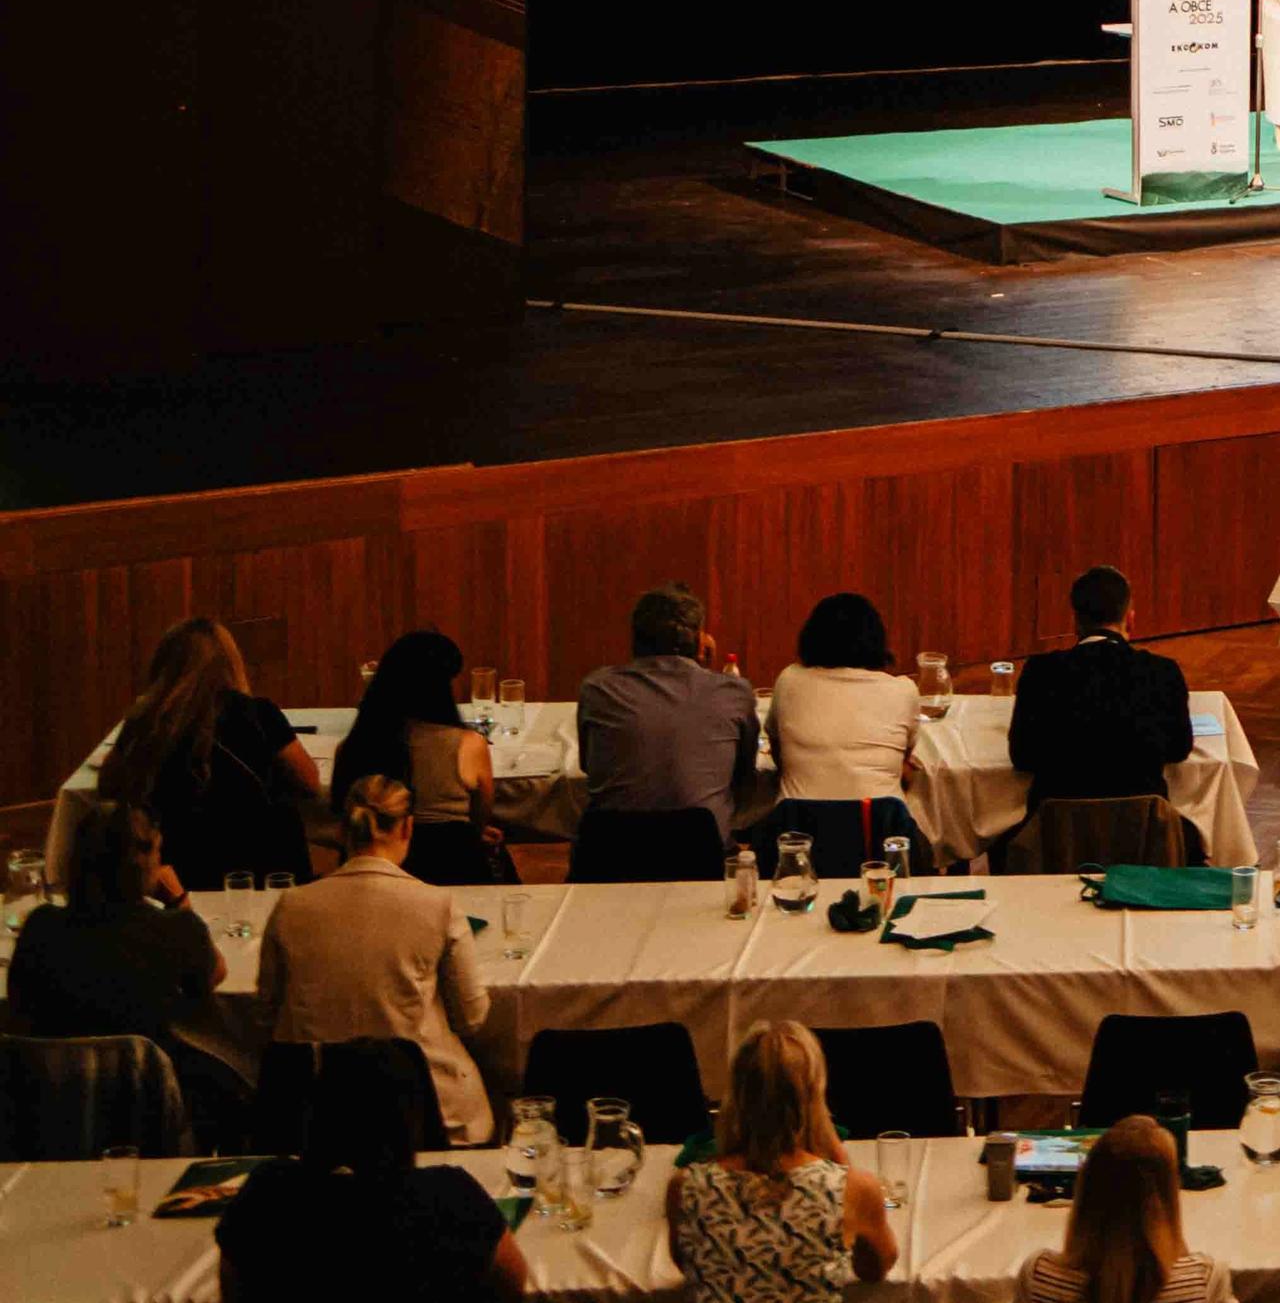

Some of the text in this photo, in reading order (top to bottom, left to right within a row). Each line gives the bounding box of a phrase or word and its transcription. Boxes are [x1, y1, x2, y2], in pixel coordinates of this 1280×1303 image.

[1168, 0, 1212, 14] A OBCE
[1189, 11, 1223, 25] 2025
